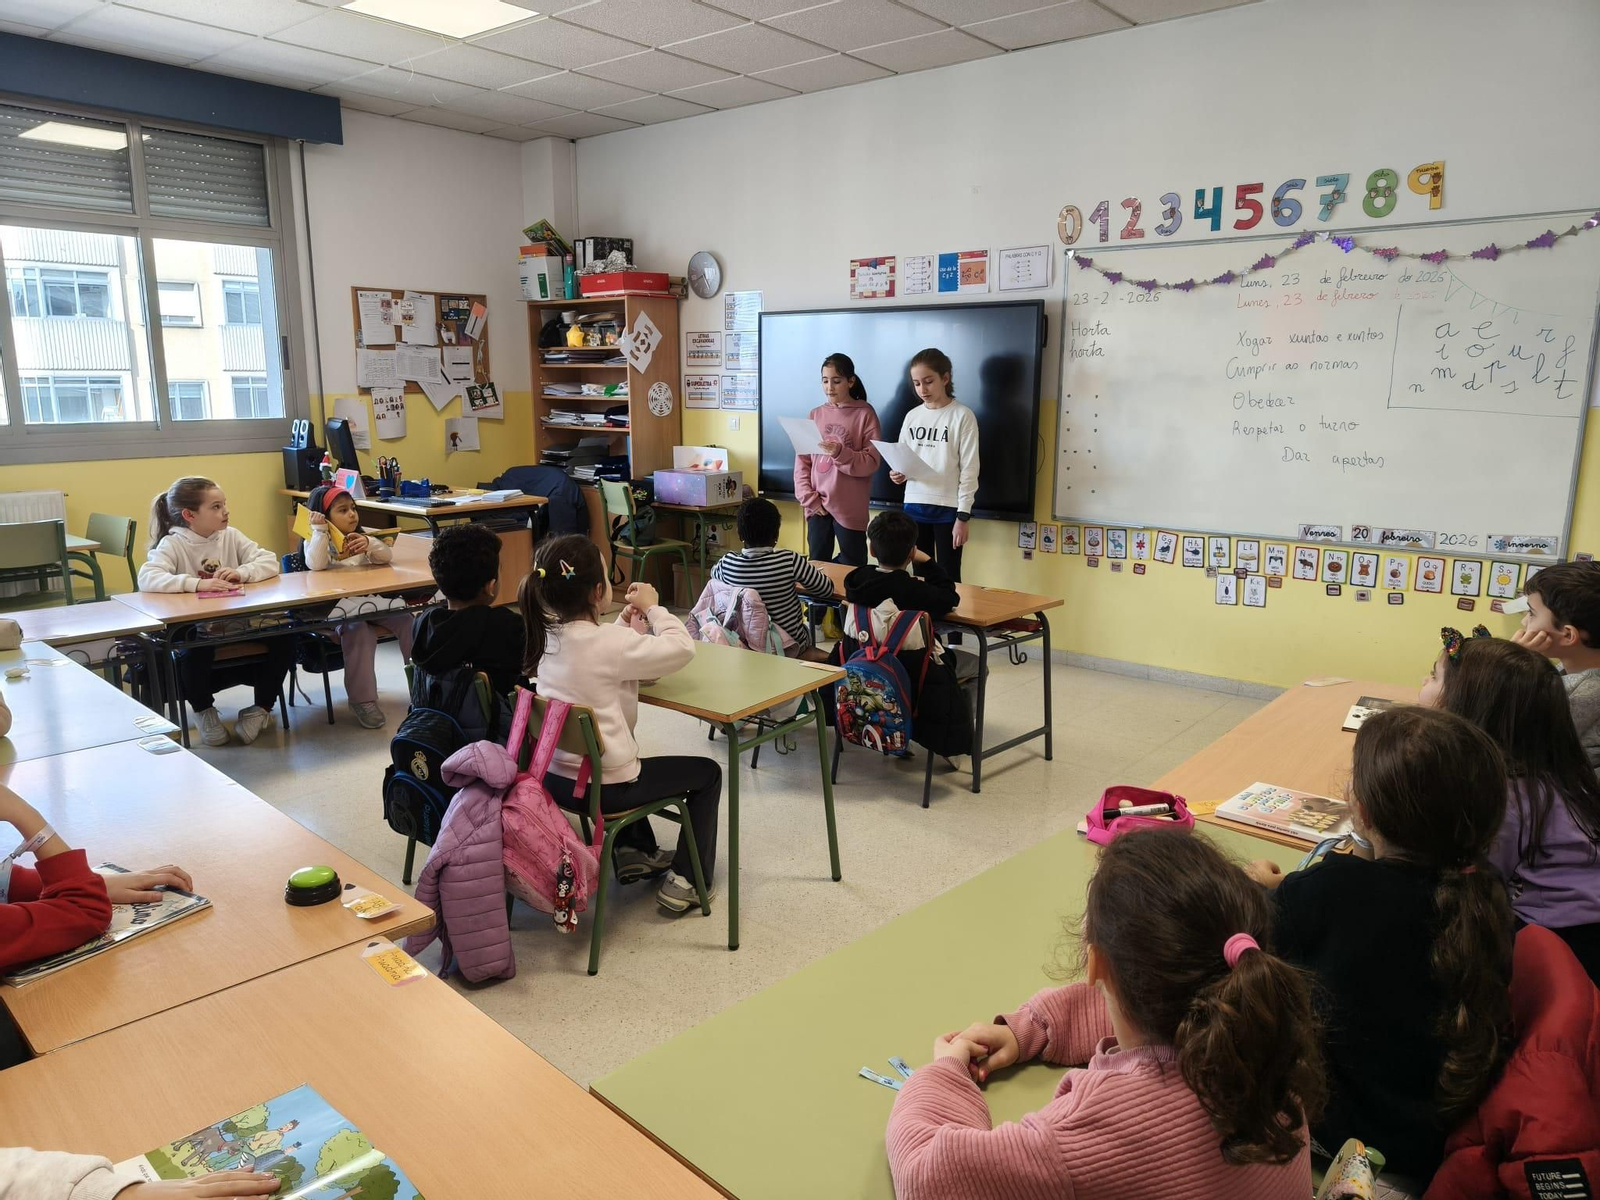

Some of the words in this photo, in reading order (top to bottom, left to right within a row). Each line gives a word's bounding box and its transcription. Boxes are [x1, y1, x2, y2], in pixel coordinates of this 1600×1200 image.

[1058, 205, 1082, 245] 0
[1088, 200, 1109, 242] 1
[1120, 197, 1144, 239] 2
[1155, 192, 1182, 236] 3
[1194, 187, 1223, 231] 4
[1233, 183, 1263, 230] 5
[1271, 178, 1306, 226] 6
[1316, 173, 1349, 222] 7
[1362, 168, 1398, 218] 8
[1407, 160, 1445, 210] 9
[1282, 274, 1300, 286] 23
[1319, 270, 1332, 284] de
[1337, 267, 1388, 288] febreiro
[1415, 271, 1448, 283] 2026
[1283, 293, 1302, 306] 23
[1317, 290, 1328, 301] de
[1330, 288, 1379, 307] febrero
[1071, 321, 1111, 338] Horta
[1435, 323, 1460, 339] a
[1472, 321, 1500, 340] e
[1237, 331, 1273, 356] Xogar
[1289, 330, 1329, 344] xuntas
[1336, 334, 1342, 342] e
[1346, 327, 1384, 343] xuntos
[1069, 345, 1105, 361] horta
[1465, 343, 1495, 358] o
[1508, 344, 1534, 361] u
[1555, 335, 1576, 369] f
[1226, 356, 1277, 380] Cumprir
[1285, 362, 1299, 370] as
[1310, 359, 1359, 371] normas
[1431, 366, 1457, 379] m
[1484, 360, 1507, 383] p
[1531, 352, 1550, 384] l
[1409, 382, 1425, 393] n
[1462, 373, 1484, 391] d
[1554, 369, 1578, 399] t
[1233, 390, 1295, 410] Obedecer
[909, 426, 949, 442] VOILÀ
[1232, 420, 1284, 442] Respetar
[1299, 423, 1306, 431] o
[1319, 414, 1360, 431] turno
[1281, 446, 1311, 462] Dar
[1332, 450, 1385, 473] apertas
[1303, 527, 1337, 537] Venres
[1353, 527, 1369, 539] 20
[1381, 531, 1422, 544] febreiro
[1440, 532, 1479, 546] 2026
[1507, 541, 1548, 549] inverno
[1390, 558, 1395, 566] P
[1461, 563, 1467, 571] R
[1498, 565, 1504, 573] S
[1531, 1171, 1562, 1181] FUTURE
[1535, 1182, 1565, 1191] BEGINS
[1538, 1191, 1564, 1200] TODAY
